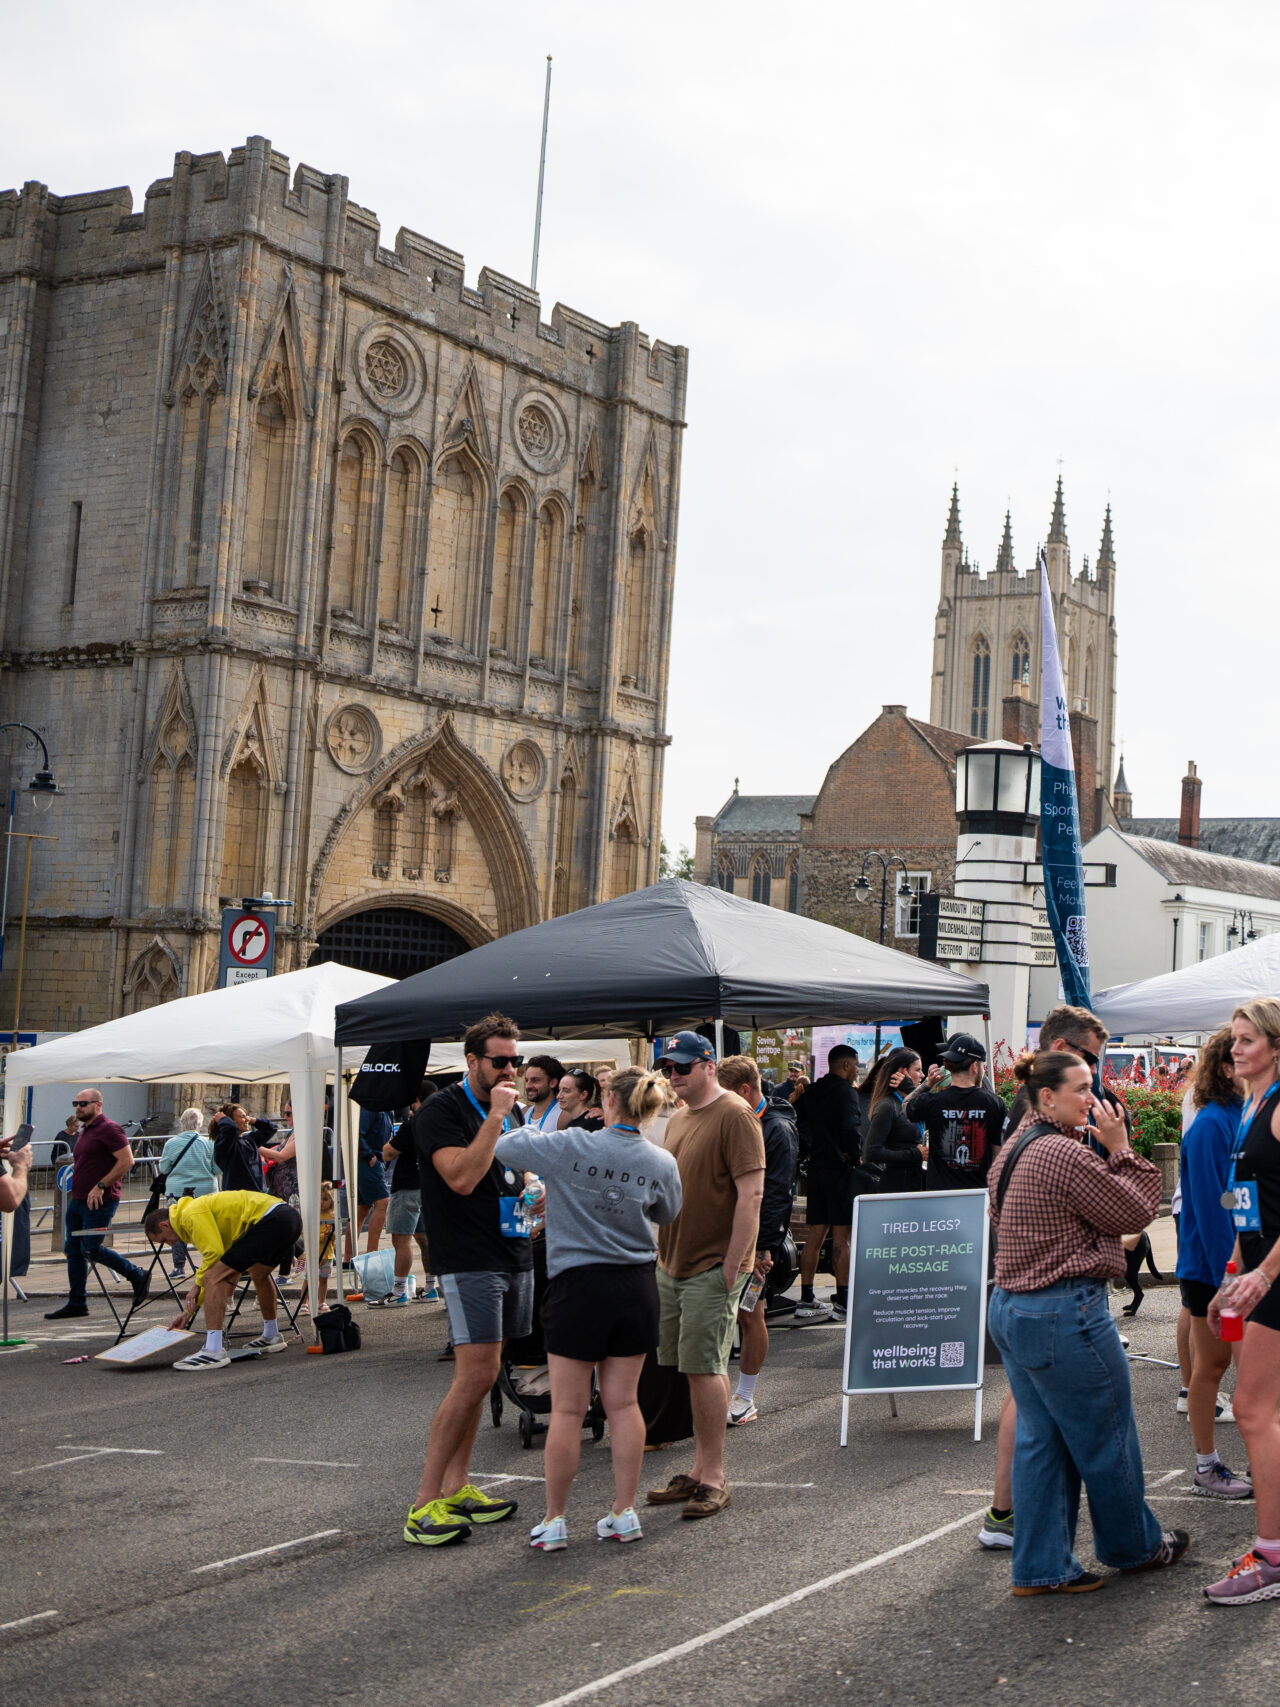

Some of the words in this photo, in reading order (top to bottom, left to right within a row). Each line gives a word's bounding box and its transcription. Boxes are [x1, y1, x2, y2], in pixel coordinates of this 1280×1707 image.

[940, 901, 968, 914] YARMOUTH
[938, 921, 969, 935] MILDENHALL
[938, 943, 963, 956] THETFORD
[1034, 951, 1055, 961] SUDBURY
[235, 970, 259, 979] Except
[756, 1035, 776, 1046] Saving
[756, 1046, 781, 1055] heritage
[755, 1055, 770, 1064] skills
[572, 1161, 660, 1191] LONDON
[881, 1221, 919, 1234] TIRED
[922, 1218, 961, 1232] LEGS?
[865, 1247, 898, 1259] FREE
[901, 1242, 974, 1258] POST-RACE
[888, 1260, 950, 1274] MASSAGE
[868, 1288, 882, 1296] Give
[929, 1285, 954, 1293] recovery
[886, 1294, 910, 1302] deserve
[944, 1313, 957, 1321] your
[872, 1343, 937, 1358] wellbeing
[872, 1358, 897, 1369] that
[899, 1356, 936, 1368] works
